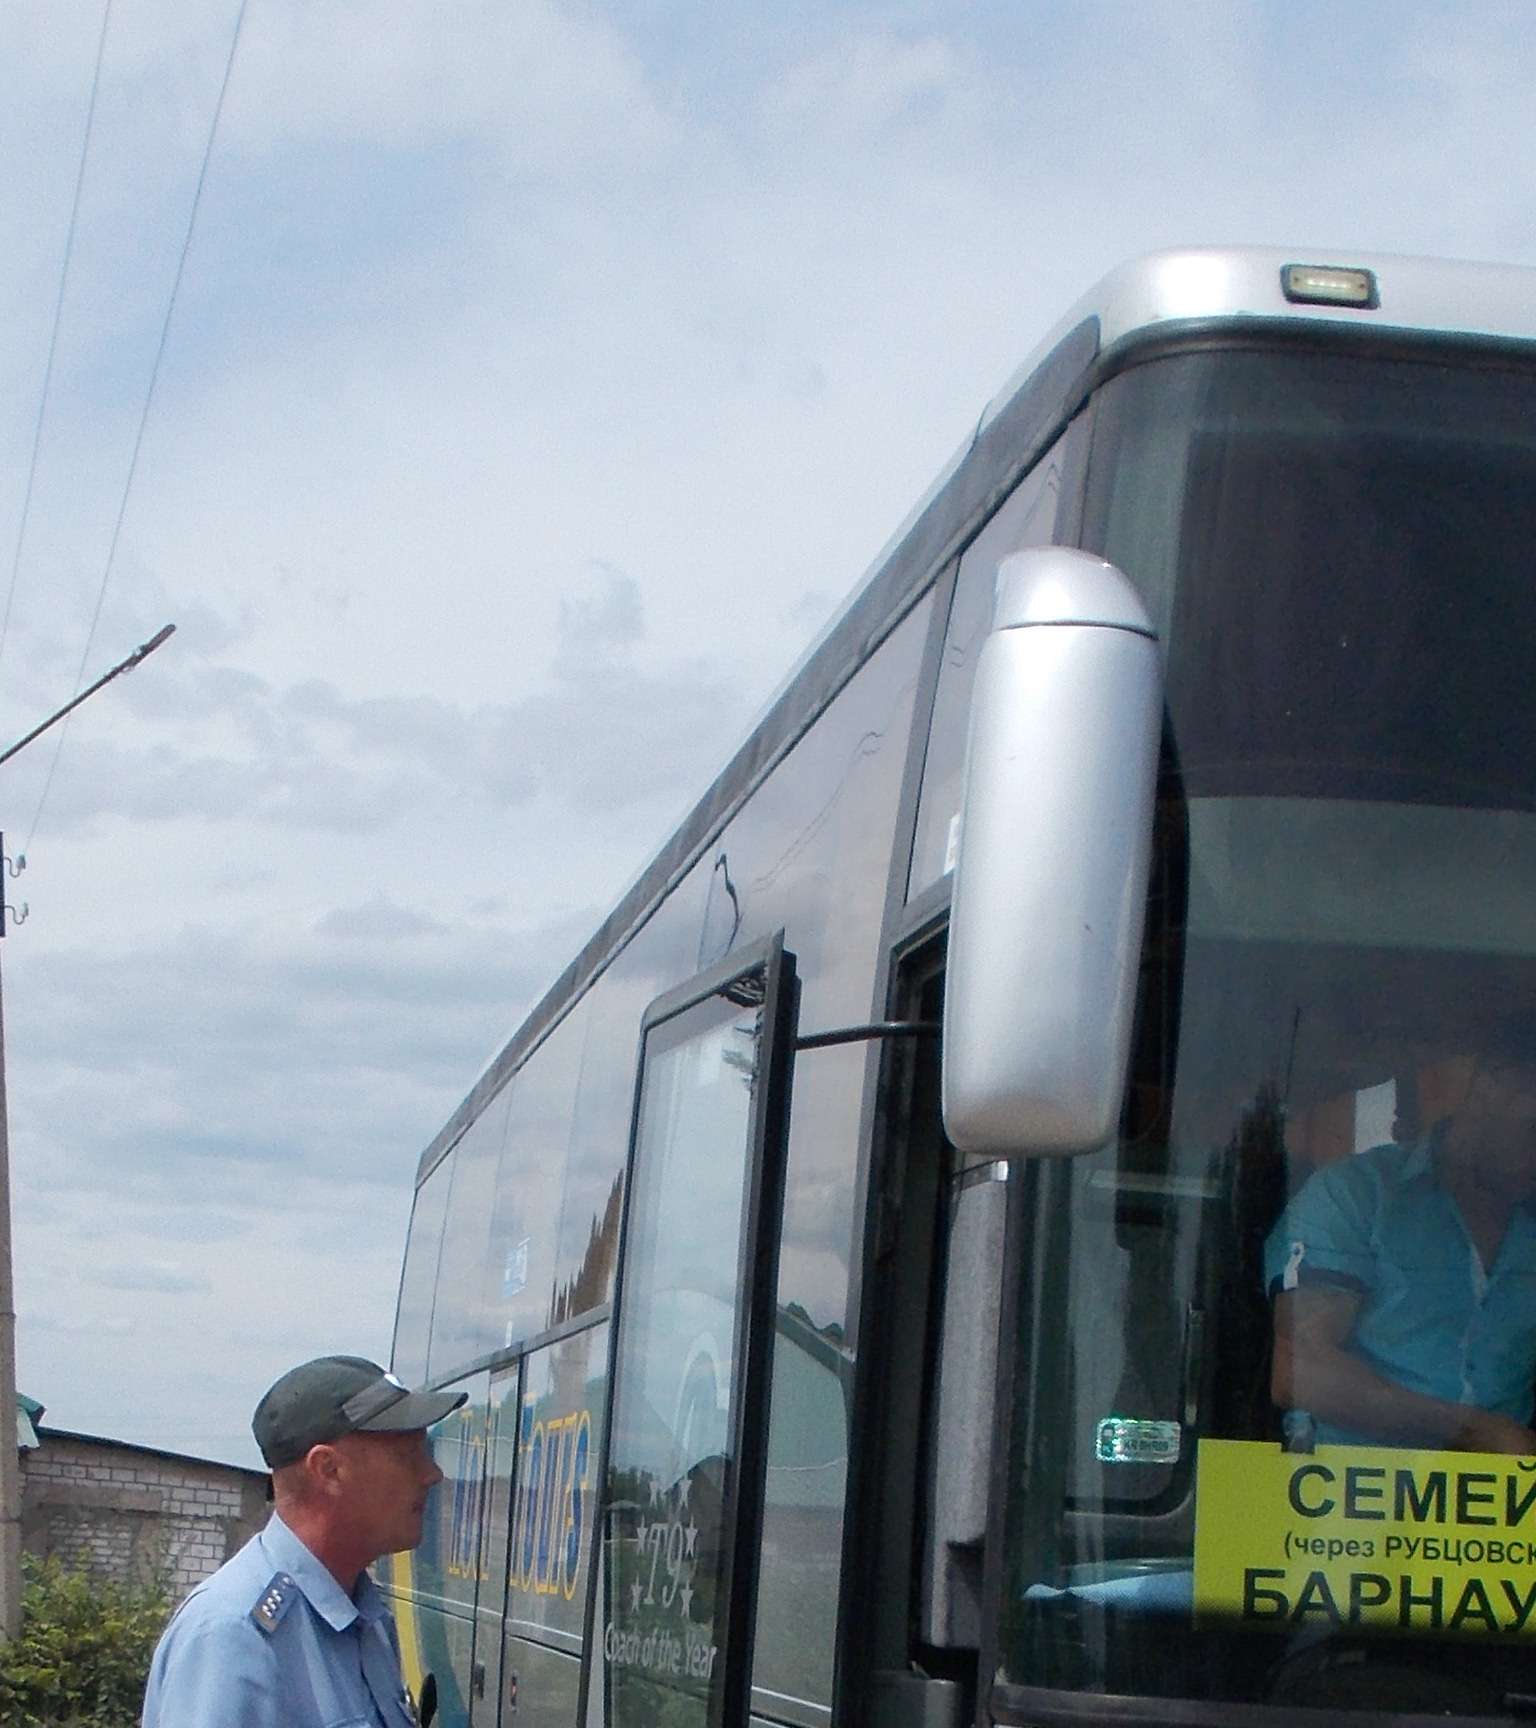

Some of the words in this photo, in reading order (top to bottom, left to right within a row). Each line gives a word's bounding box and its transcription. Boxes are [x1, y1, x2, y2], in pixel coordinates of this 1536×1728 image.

[1284, 1532, 1375, 1561] (через
[604, 1621, 640, 1664] Coach
[642, 1627, 658, 1668] of
[658, 1629, 680, 1673] the
[685, 1628, 717, 1680] Year
